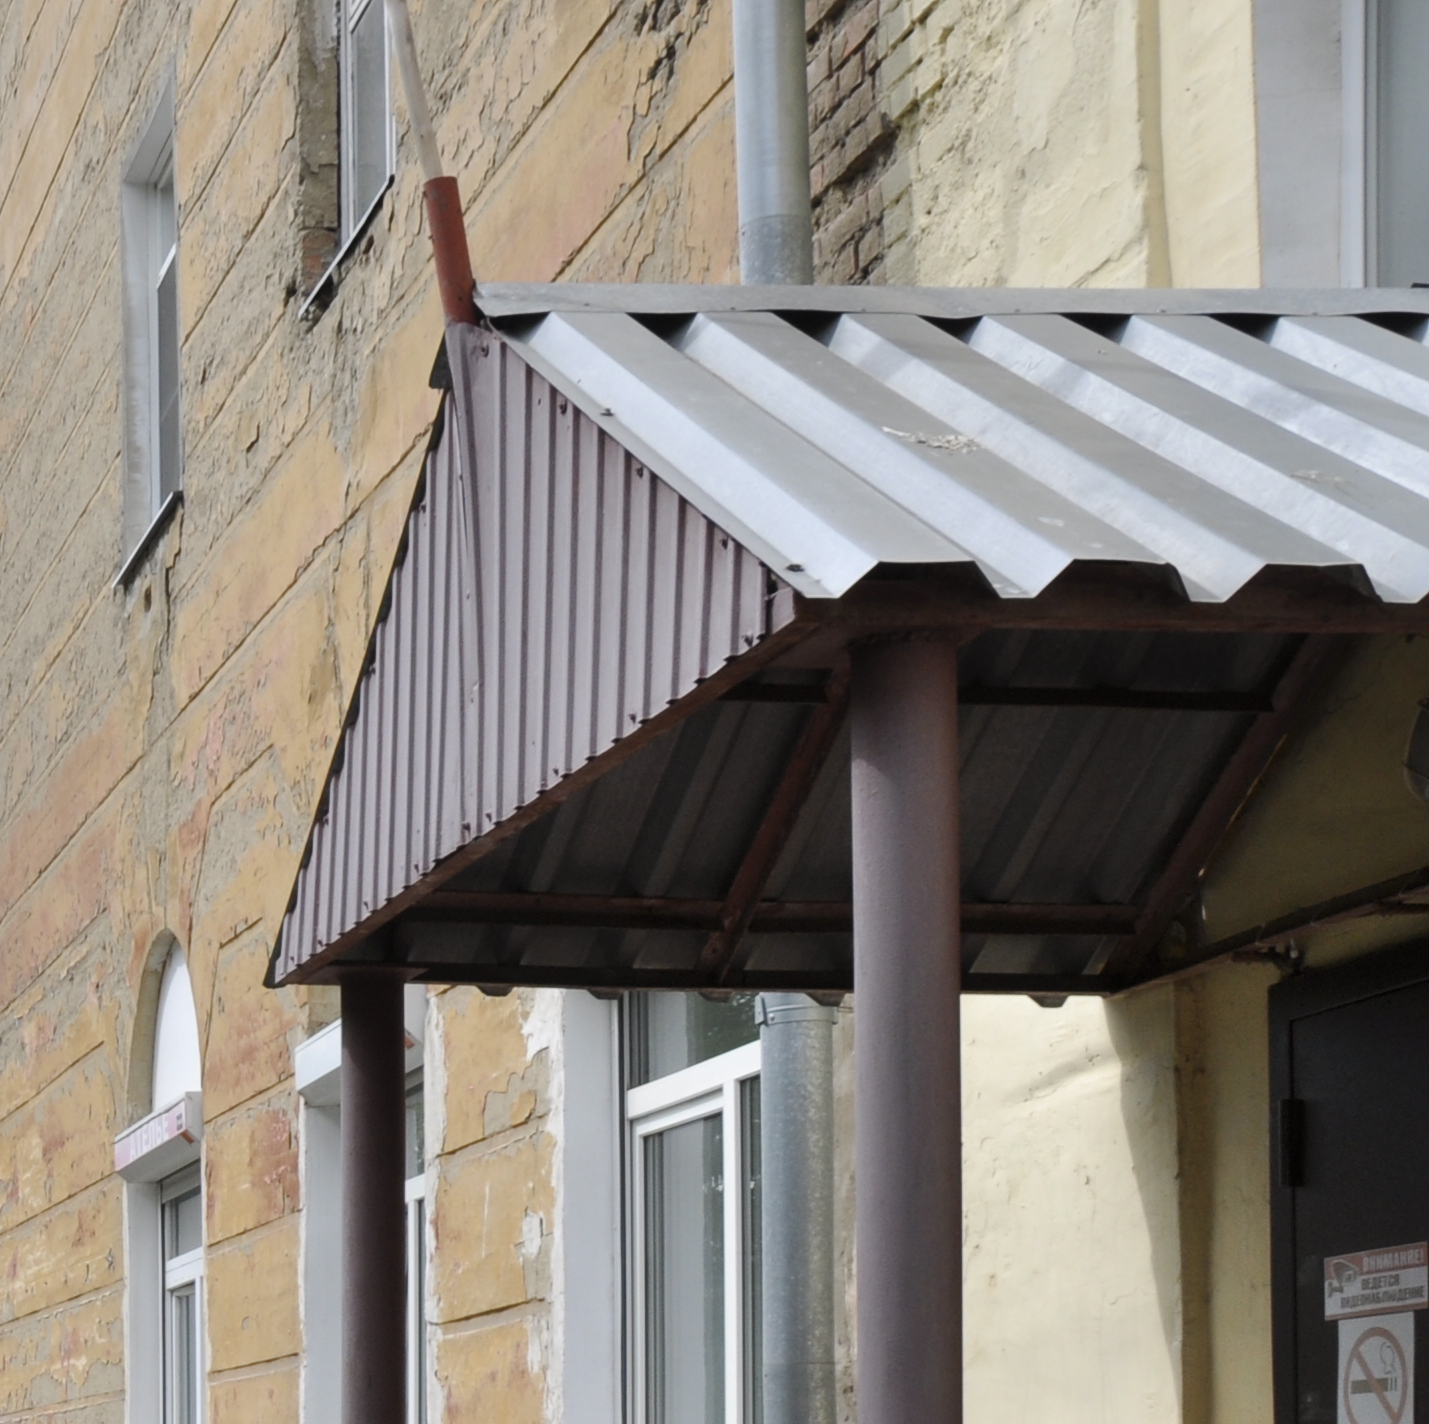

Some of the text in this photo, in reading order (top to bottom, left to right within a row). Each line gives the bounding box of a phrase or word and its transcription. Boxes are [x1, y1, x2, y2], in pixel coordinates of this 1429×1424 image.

[129, 1114, 169, 1160] АТЕЛЬЕ
[1362, 1248, 1424, 1272] ВНИМАНИЕ!
[1361, 1273, 1400, 1290] ВЕДЕТСЯ
[1341, 1285, 1425, 1309] ВИДЕОНАБЛЮДЕНИЕ
